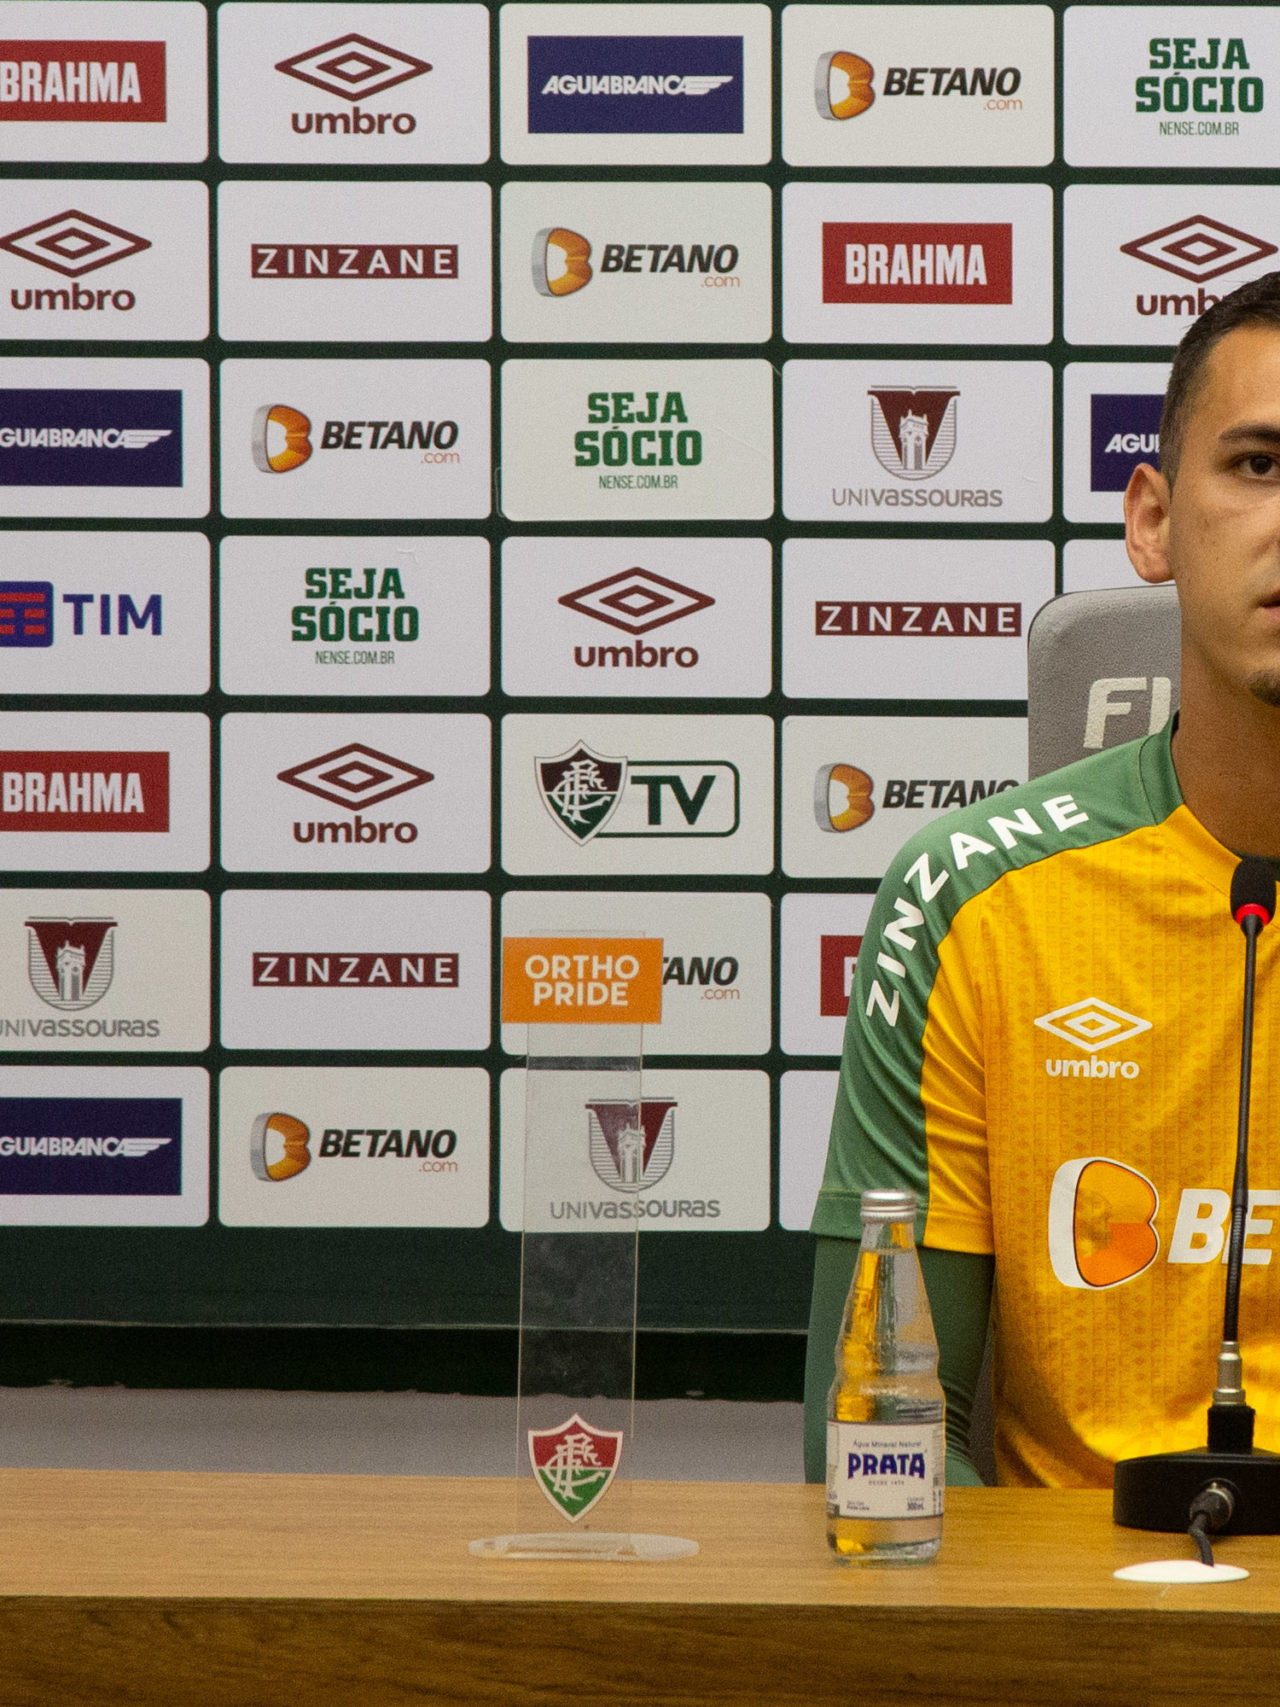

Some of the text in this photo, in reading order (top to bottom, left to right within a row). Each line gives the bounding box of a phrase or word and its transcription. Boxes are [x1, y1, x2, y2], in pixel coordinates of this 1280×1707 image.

[1150, 38, 1249, 69] SEJA
[0, 62, 141, 102] BRAHMA
[883, 68, 1021, 96] BETANO
[1136, 72, 1263, 112] SÓCIO
[292, 107, 416, 134] umbro
[1159, 121, 1239, 136] NENSE.COM.BR
[257, 249, 453, 276] ZINZANE
[601, 245, 738, 273] BETANO
[846, 244, 987, 285] BRAHMA
[11, 283, 135, 311] umbro
[1136, 288, 1228, 316] umb
[588, 392, 687, 423] SEJA
[0, 428, 128, 448] GUIABRANCA
[321, 421, 458, 449] BETANO
[575, 426, 701, 466] SÓCIO
[599, 475, 678, 489] NENSE.COM.BR
[306, 568, 404, 599] SEJA
[63, 594, 161, 635] TIM
[292, 602, 418, 642] SÓCIO
[821, 606, 1016, 631] ZINZANE
[315, 650, 394, 665] NENSE.COM.BR
[575, 640, 698, 668] umbro
[3, 772, 144, 812] BRAHMA
[631, 776, 715, 825] TV
[294, 816, 418, 843] umbro
[866, 794, 1089, 1027] ZINZANE
[258, 957, 454, 981] ZINZANE
[525, 955, 639, 979] ORTHO
[663, 957, 739, 986] ANO
[534, 982, 628, 1006] PRIDE
[1046, 1056, 1139, 1079] umbro
[0, 1136, 128, 1157] GUIABRANCA
[319, 1130, 456, 1158] BETANO
[848, 1452, 925, 1479] PRATA
